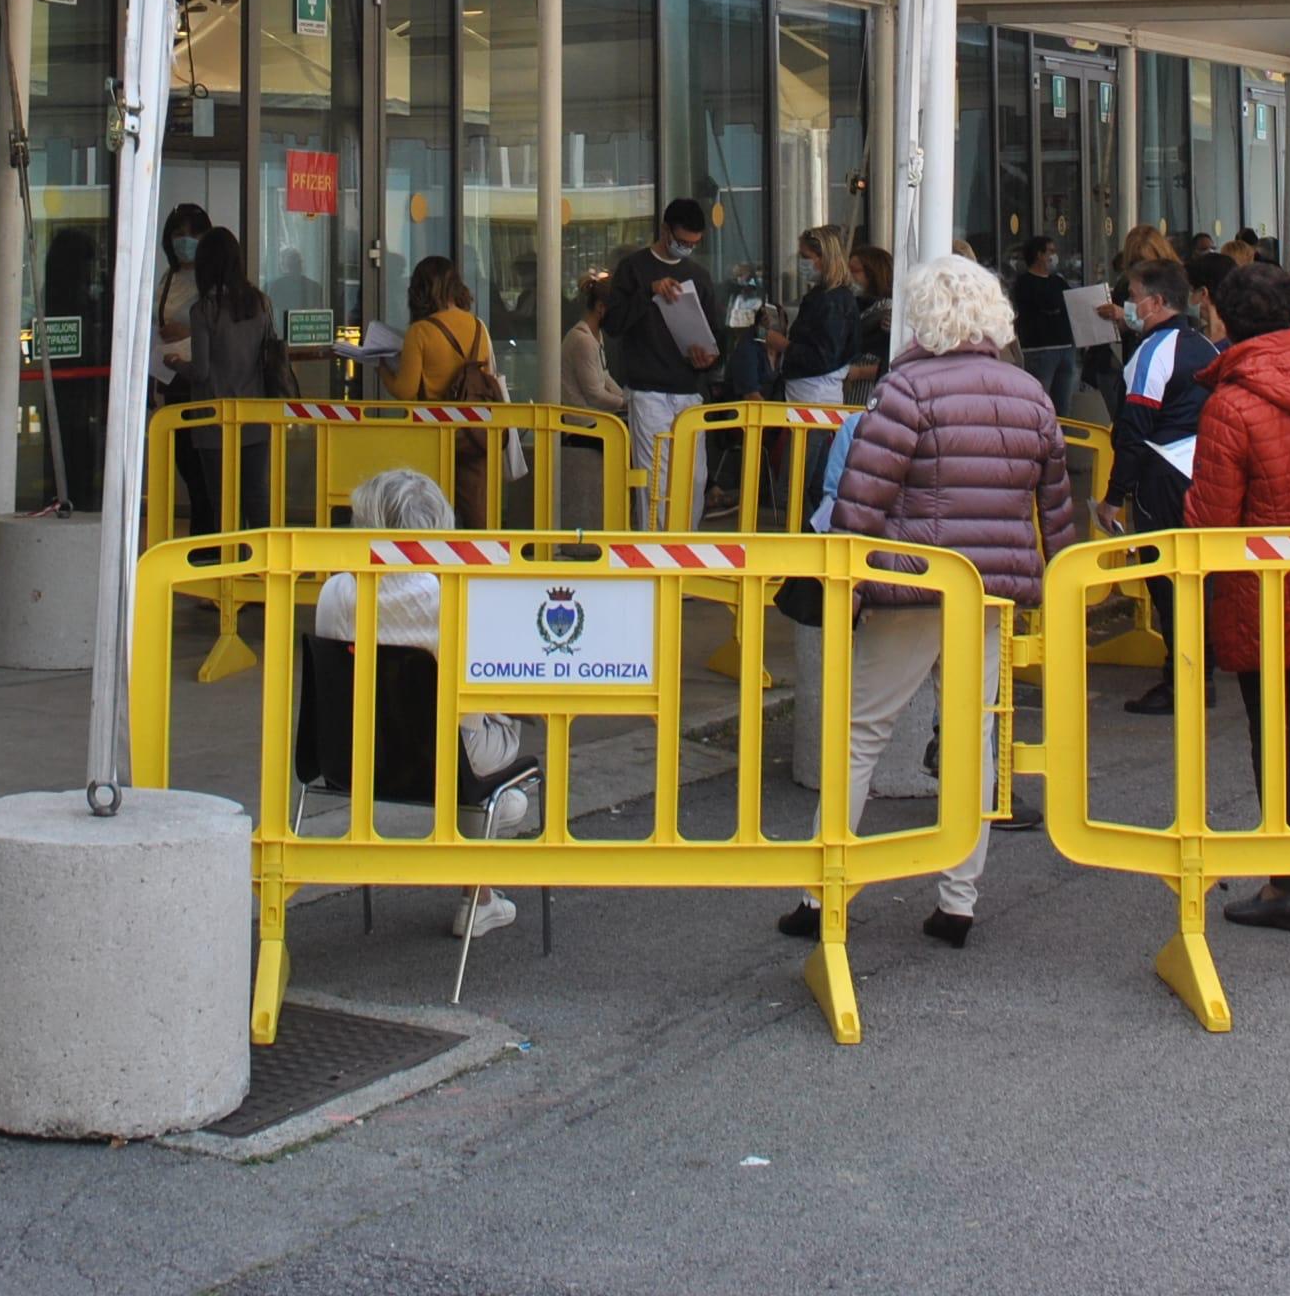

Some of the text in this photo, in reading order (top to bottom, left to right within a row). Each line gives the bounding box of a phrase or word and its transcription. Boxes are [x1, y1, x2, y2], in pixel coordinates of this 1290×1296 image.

[292, 172, 332, 192] PFIZER
[36, 323, 77, 333] NIGLIONE
[37, 334, 77, 345] TIPANICO
[470, 662, 648, 678] COMUNE DI GORIZIA
